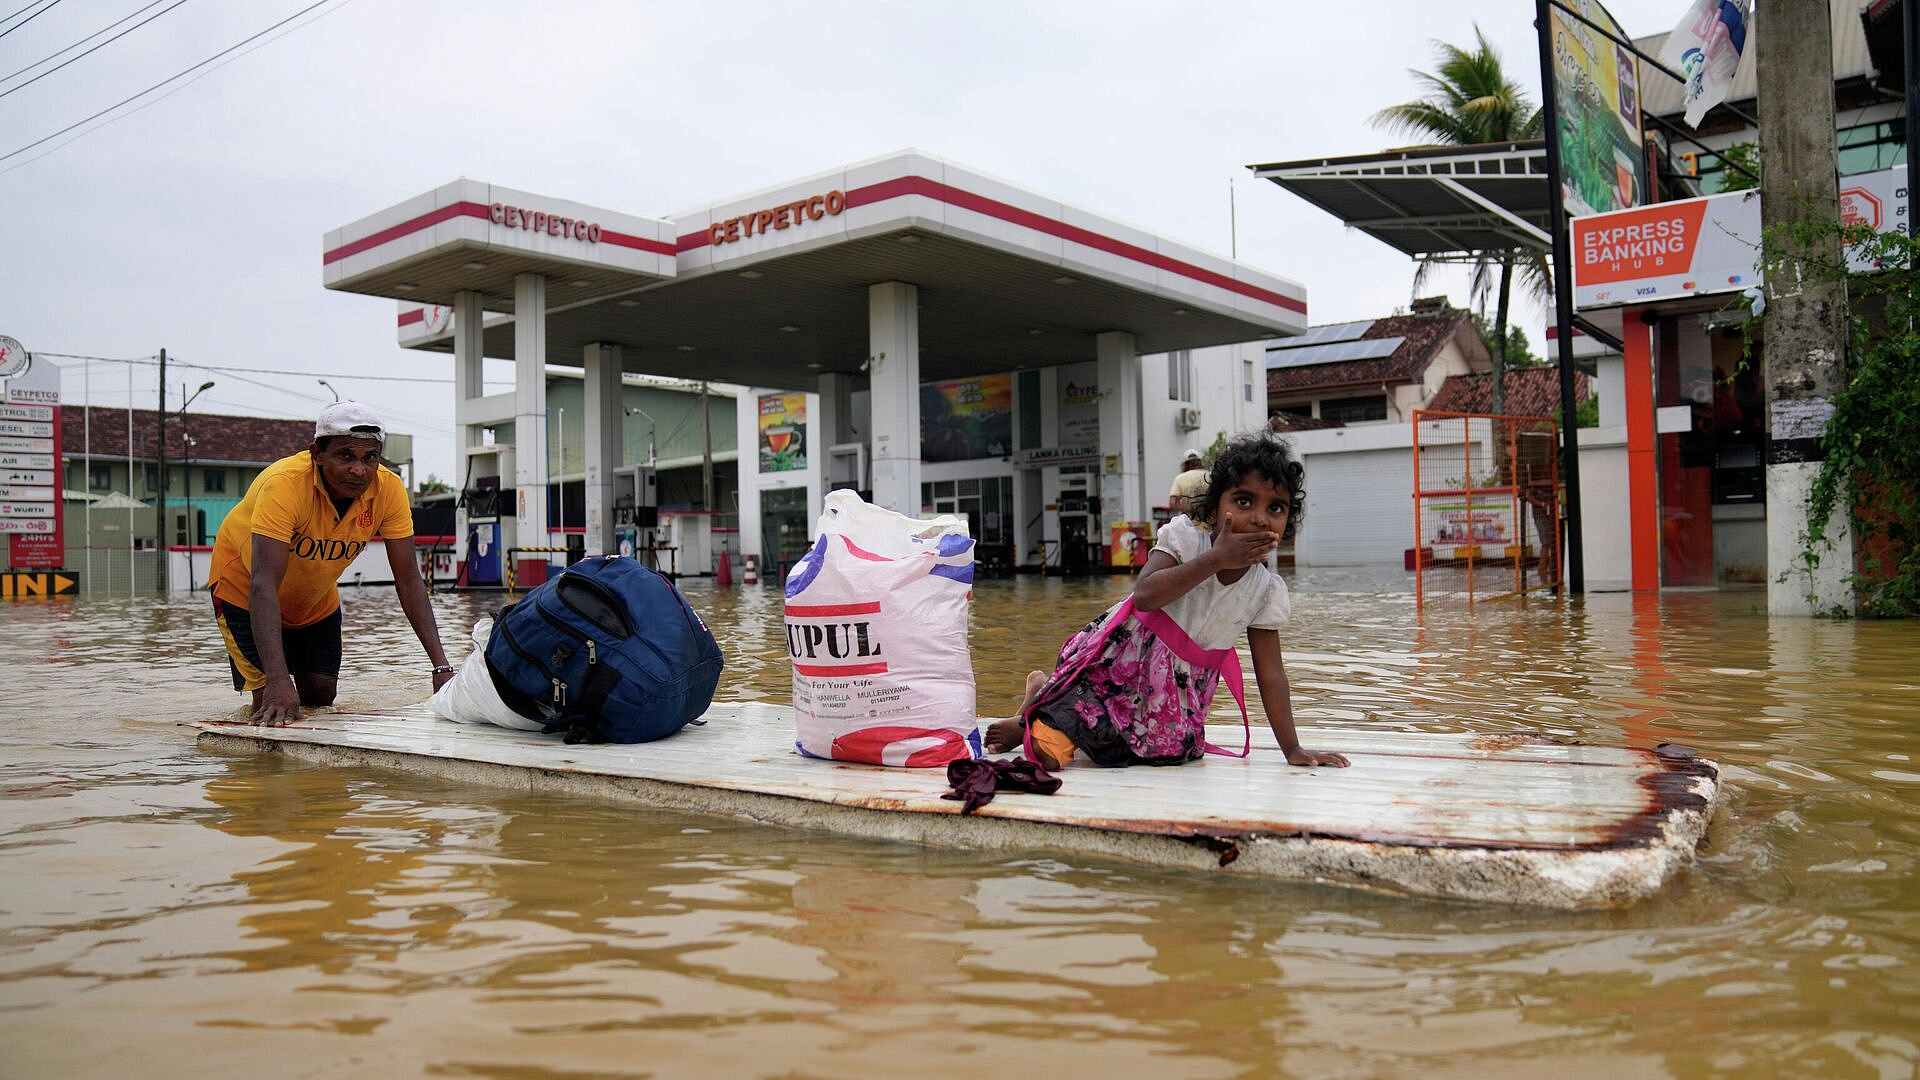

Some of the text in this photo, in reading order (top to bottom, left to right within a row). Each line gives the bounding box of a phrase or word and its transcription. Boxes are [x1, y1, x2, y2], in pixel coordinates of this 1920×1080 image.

[489, 203, 601, 243] CEYPETCO
[708, 189, 845, 246] CEYPETCO
[1584, 218, 1685, 248] EXPRESS
[1585, 236, 1685, 265] BANKING
[1636, 286, 1657, 296] VISA
[10, 389, 59, 399] CEYPETCO
[1066, 384, 1099, 397] CEYPE
[1029, 447, 1098, 459] LANKA FILLING
[20, 533, 55, 542] 24Hrs
[2, 573, 48, 596] IN
[784, 621, 882, 659] UPUL
[812, 681, 826, 689] For
[827, 681, 850, 689] Your
[857, 685, 911, 699] MULLERIYAWA
